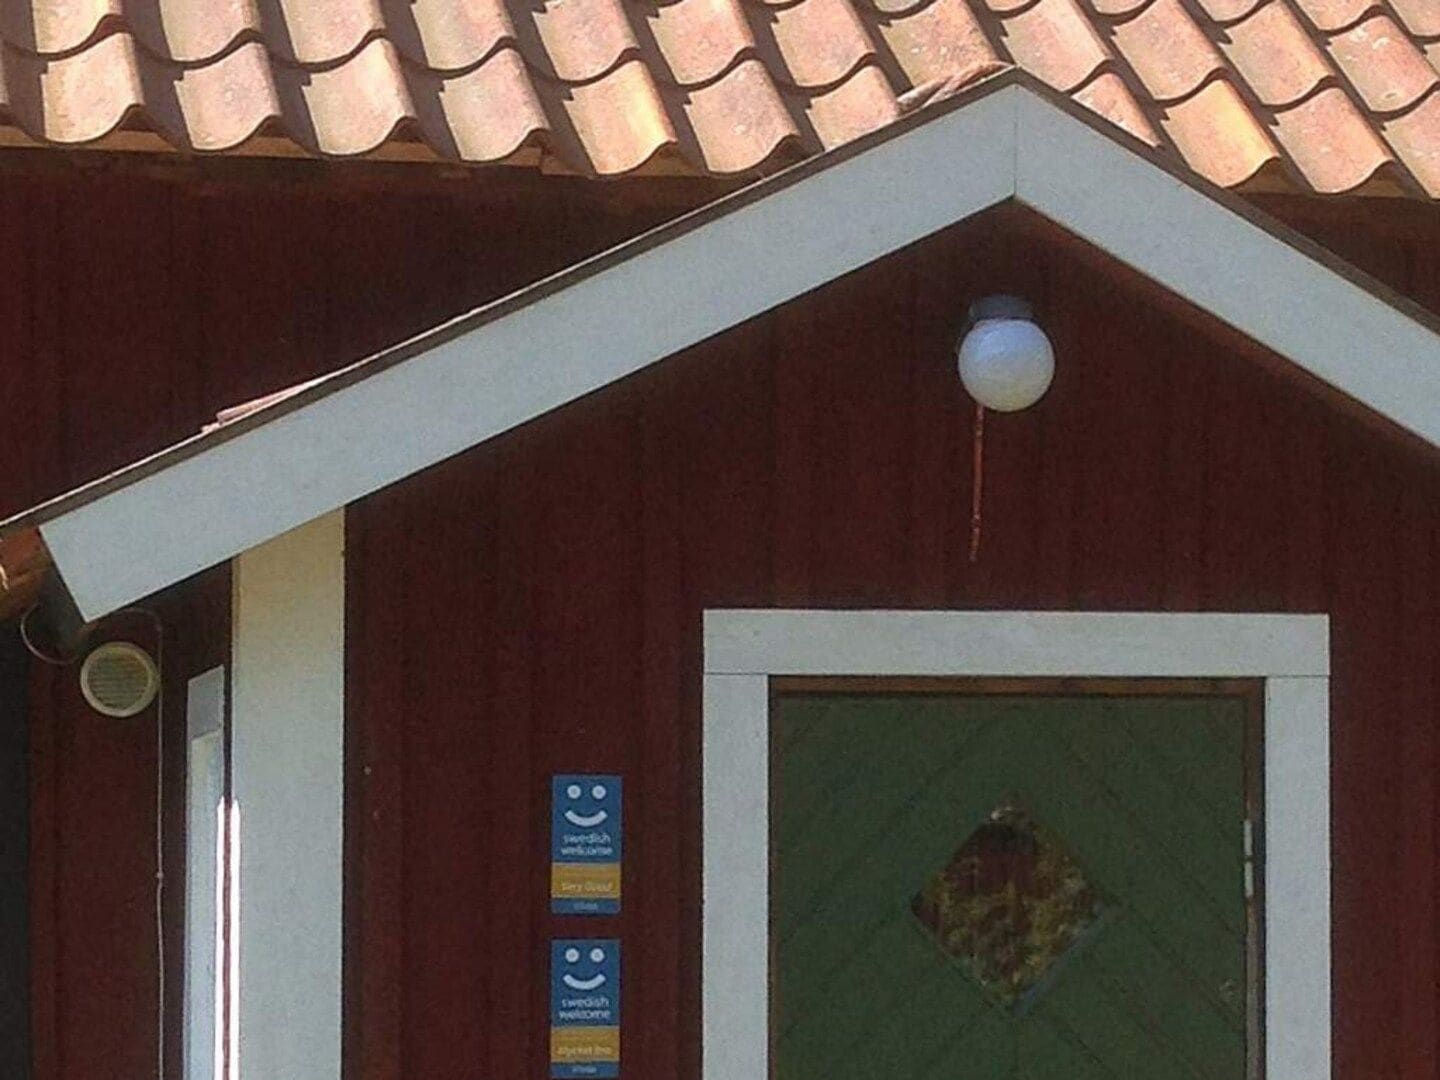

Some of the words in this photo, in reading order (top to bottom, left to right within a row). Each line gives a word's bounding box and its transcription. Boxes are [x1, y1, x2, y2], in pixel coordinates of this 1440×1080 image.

[562, 833, 611, 844] swedish
[560, 846, 613, 856] welcome
[561, 997, 609, 1008] swedish
[559, 1010, 610, 1020] welcome
